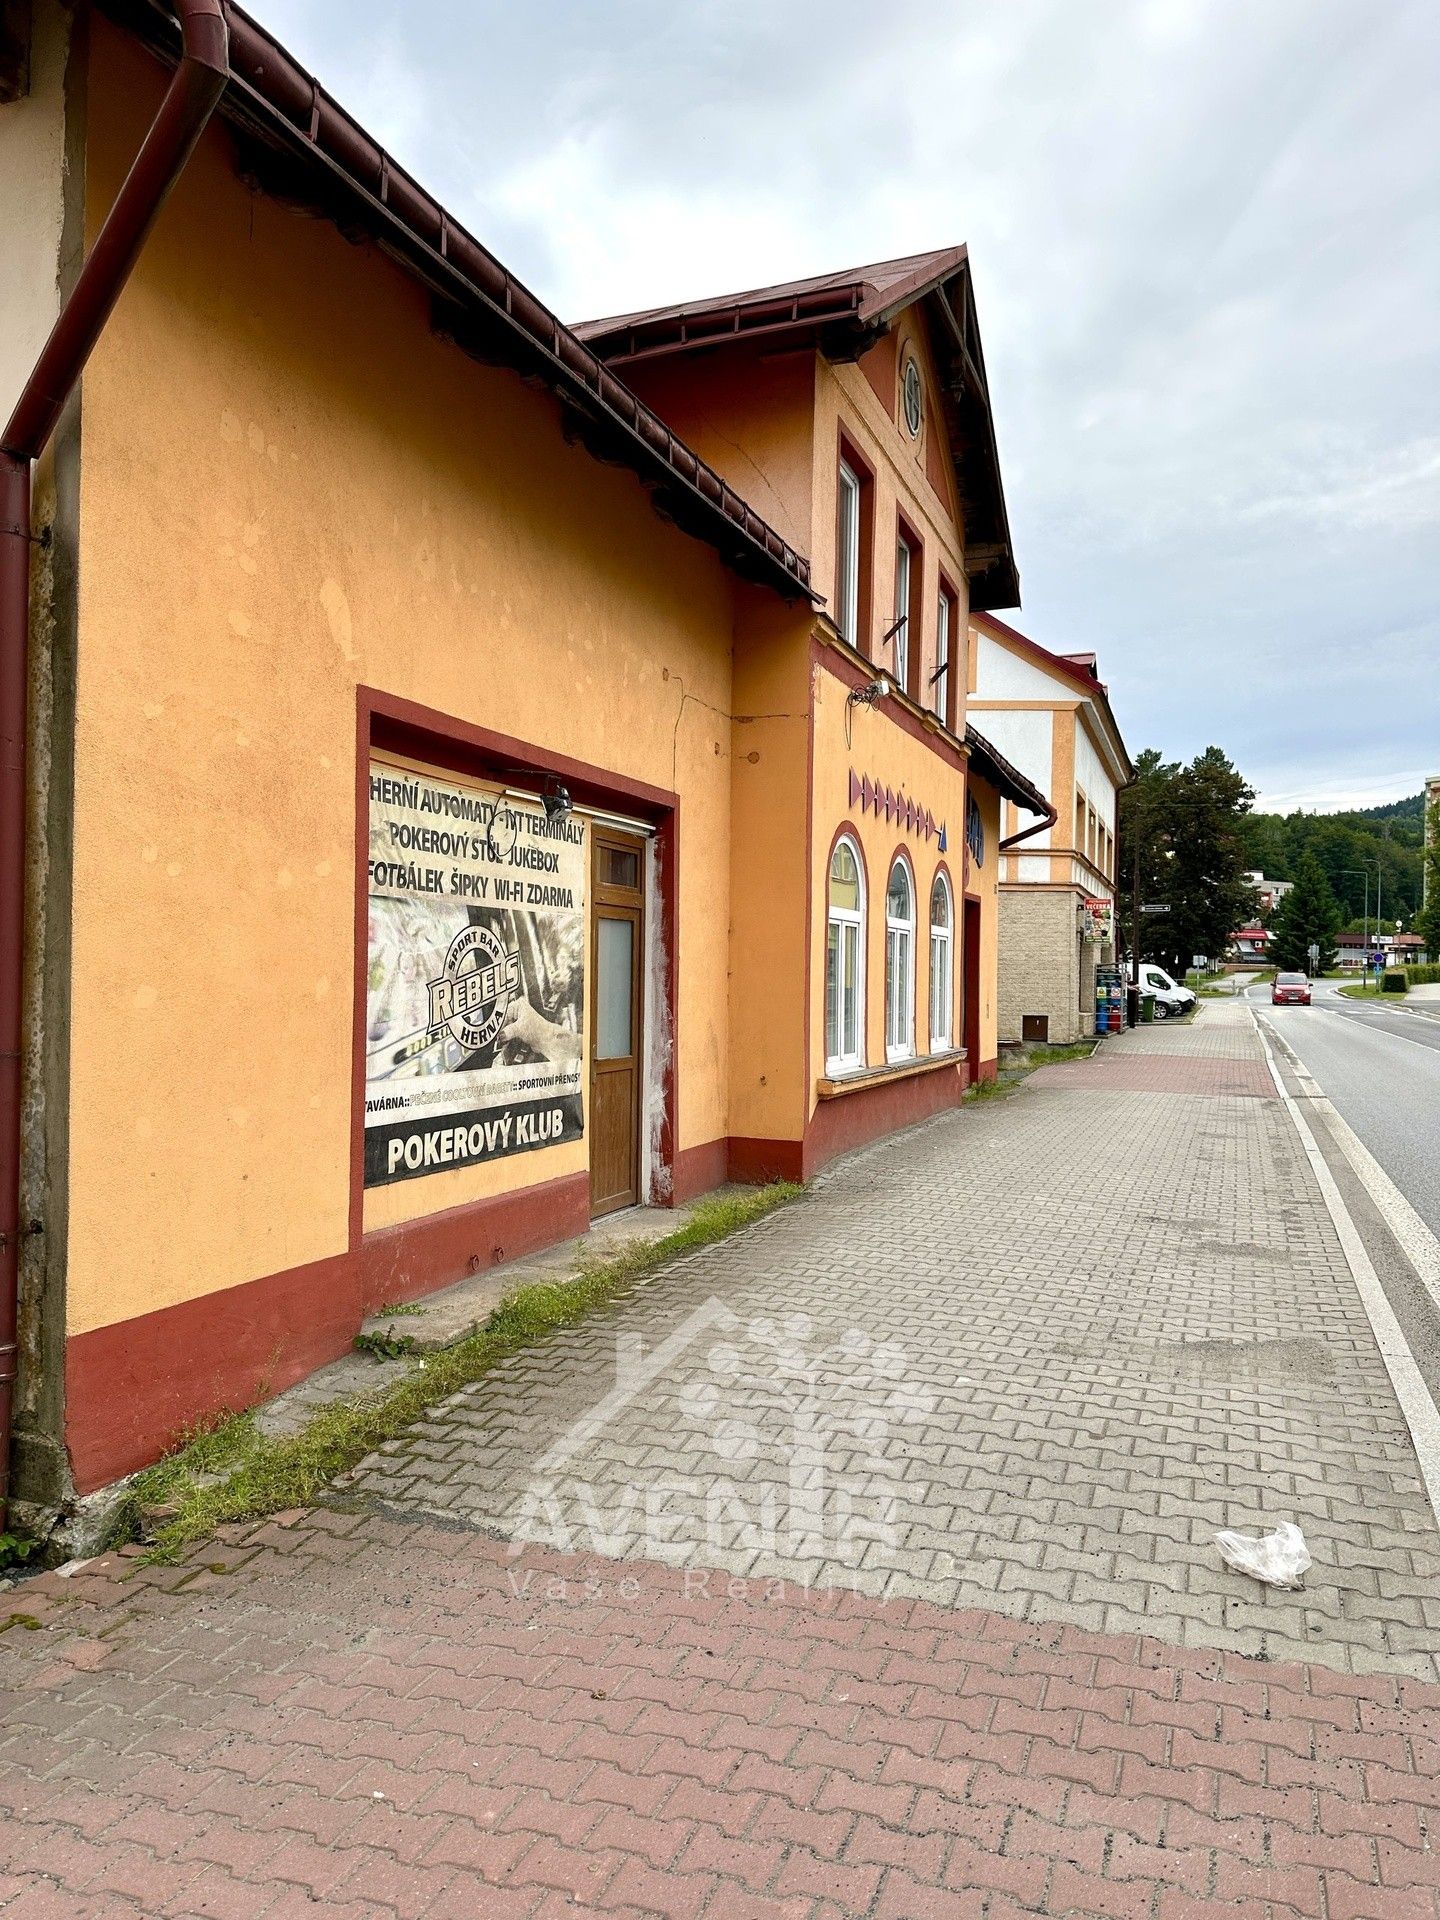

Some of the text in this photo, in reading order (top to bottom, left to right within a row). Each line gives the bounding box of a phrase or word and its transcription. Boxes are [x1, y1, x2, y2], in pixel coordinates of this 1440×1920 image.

[369, 775, 419, 809] HERNÍ
[420, 791, 497, 826] AUTOMATY
[525, 813, 584, 845] TERMINÁLY
[389, 822, 559, 873] POKEROVÝ STŮL JUKEBOX
[368, 860, 573, 908] FOTBÁLEK ŠIPKY WI-FI ZDARMA
[448, 931, 501, 972] SPORT BAR
[430, 956, 520, 1027] REBELS
[460, 1011, 504, 1046] HERNA
[518, 1074, 554, 1091] SPORTOVNÍ
[388, 1109, 563, 1175] POKEROVÝ KLUB
